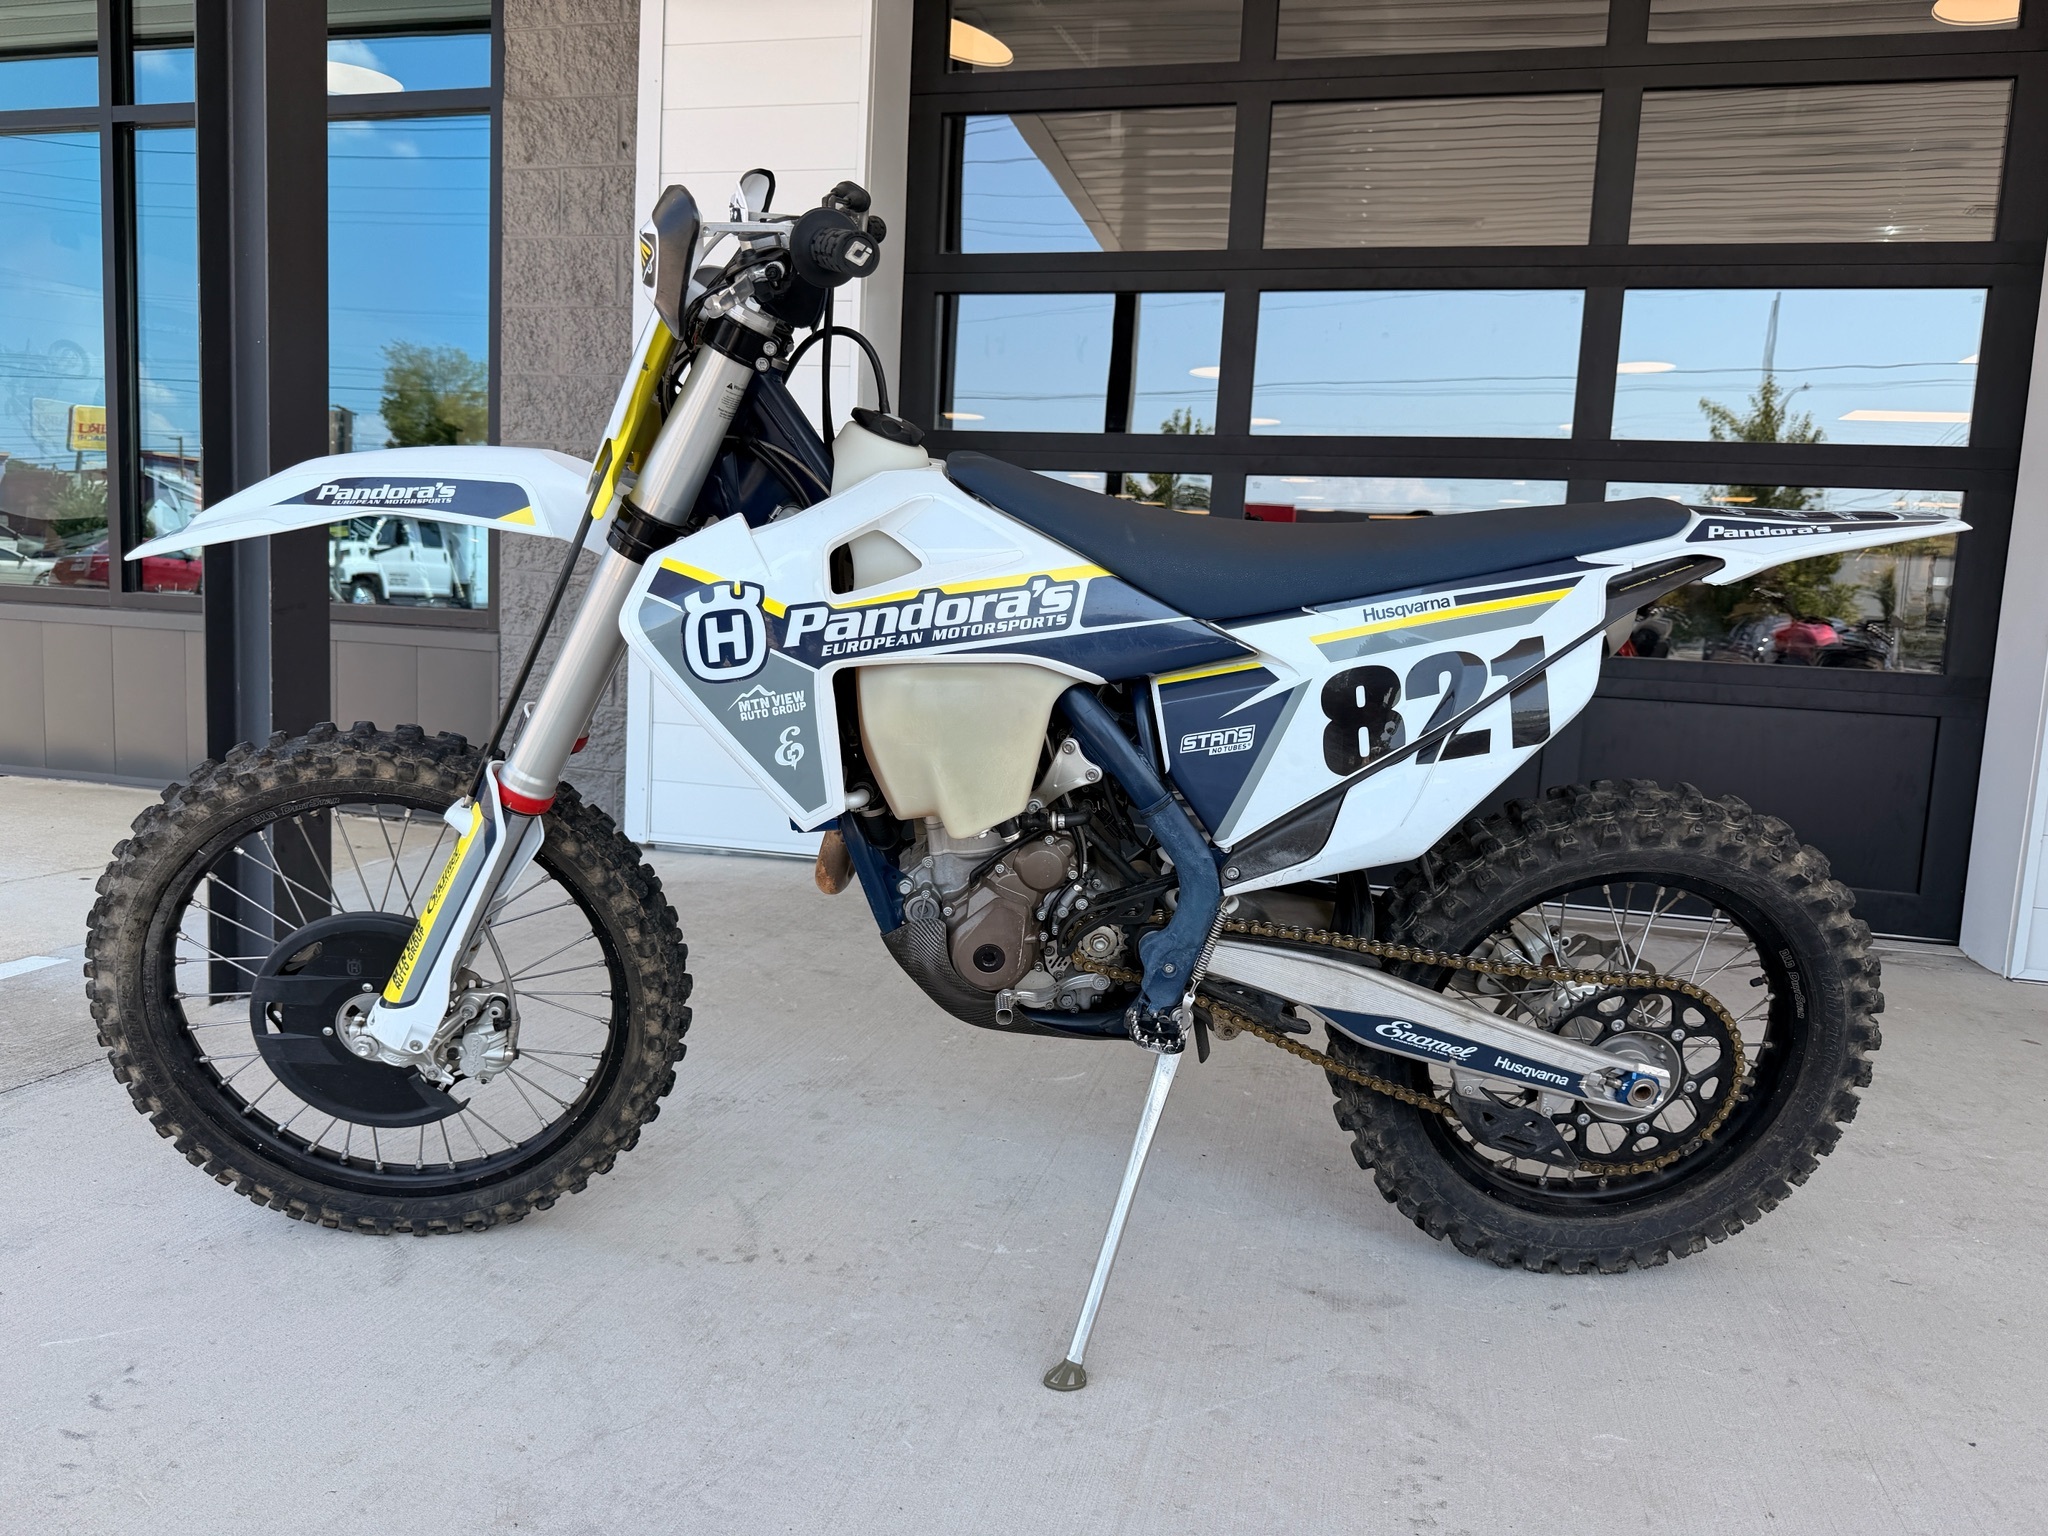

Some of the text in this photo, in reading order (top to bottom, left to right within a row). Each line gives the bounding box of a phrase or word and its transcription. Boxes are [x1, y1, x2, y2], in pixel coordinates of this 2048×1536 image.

[316, 482, 456, 500] Pandora's
[384, 497, 452, 505] MOTORSPORTS
[1708, 525, 1832, 539] Pandora's
[783, 579, 1074, 648] Pandora's
[1362, 596, 1451, 623] Husqvarna
[821, 613, 1068, 657] EUROPEAN MOTORSPORTS
[738, 690, 805, 712] MTN VIEW
[740, 702, 807, 721] AUTO GROUP
[1320, 635, 1551, 777] 821
[1182, 727, 1253, 751] STANS
[1211, 746, 1222, 754] NO
[394, 926, 425, 991] AUTO GROUP
[1375, 1020, 1479, 1058] Enamel
[1494, 1055, 1569, 1087] Husqvarna
